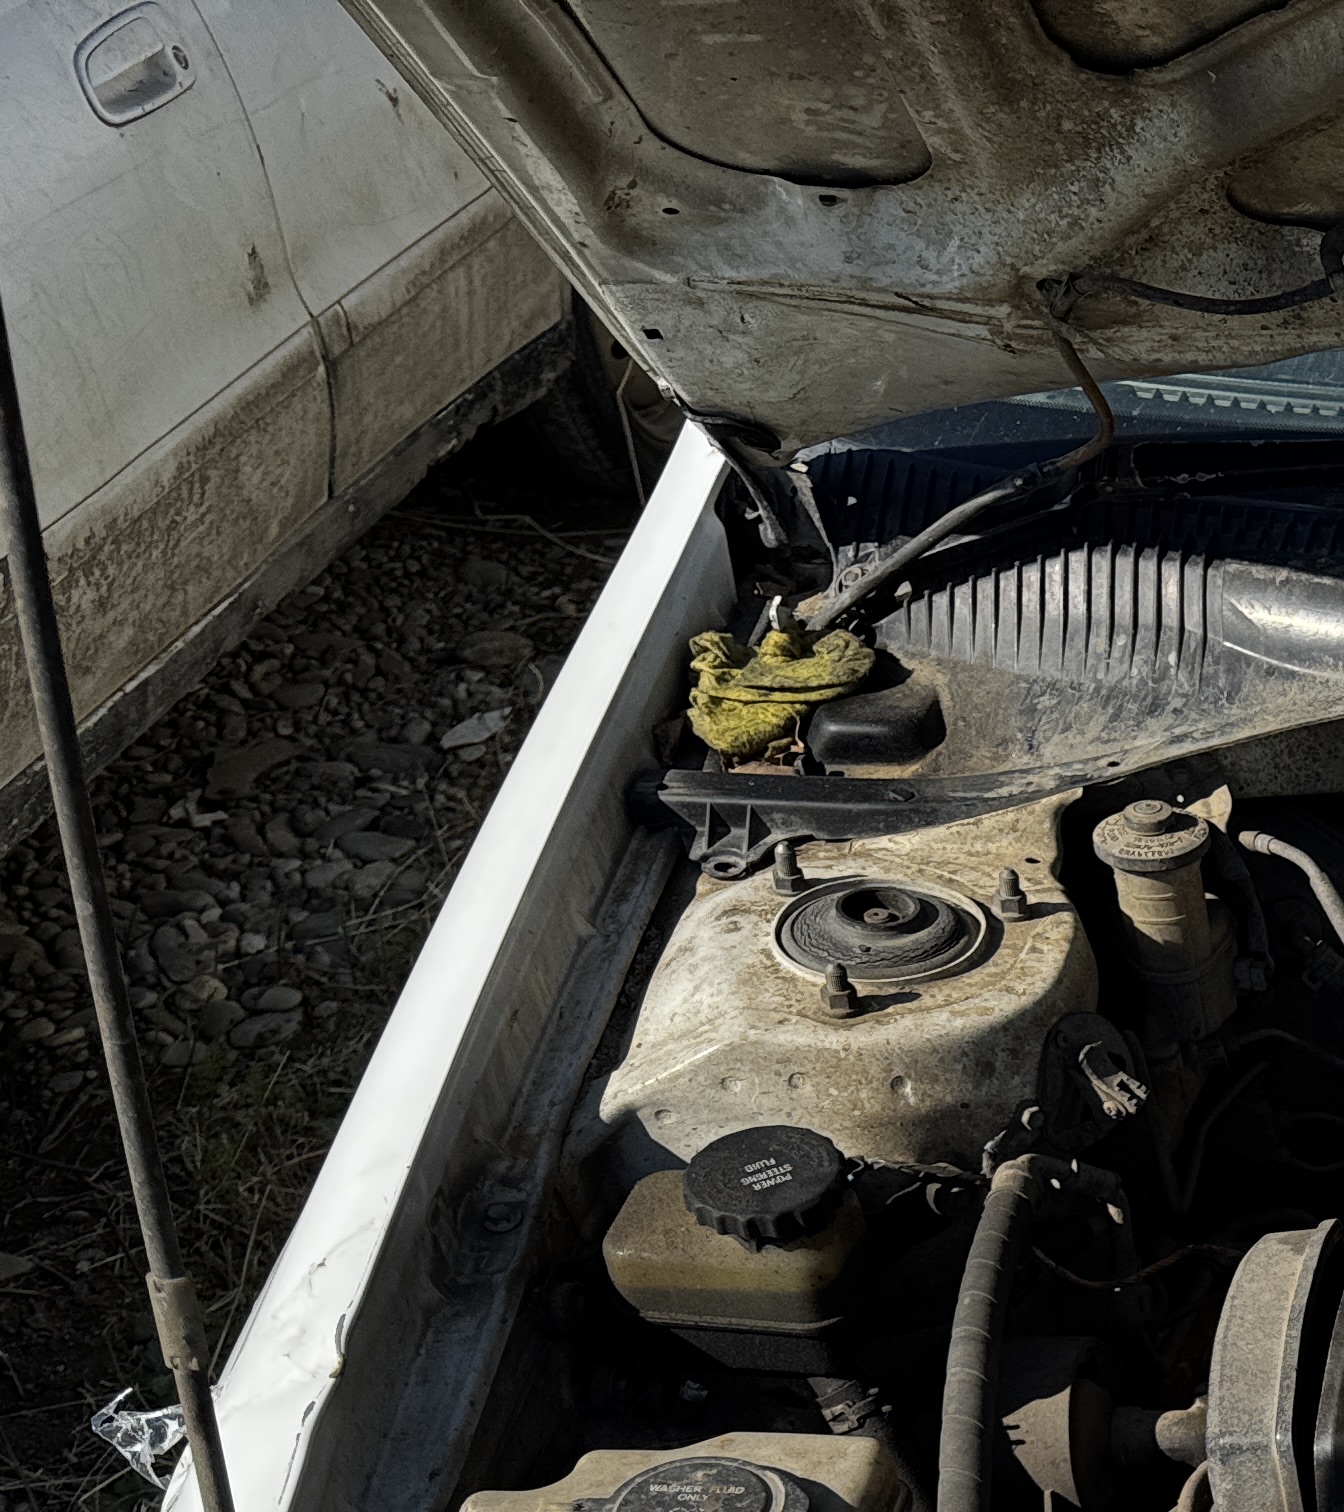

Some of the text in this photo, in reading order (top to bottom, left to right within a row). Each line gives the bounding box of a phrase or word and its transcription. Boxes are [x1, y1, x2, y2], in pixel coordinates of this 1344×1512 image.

[744, 1157, 777, 1173] FLUID
[740, 1163, 794, 1186] STEERING
[752, 1172, 793, 1191] POWER
[649, 1484, 746, 1495] WASHER FLUID
[677, 1493, 711, 1501] ONLY
